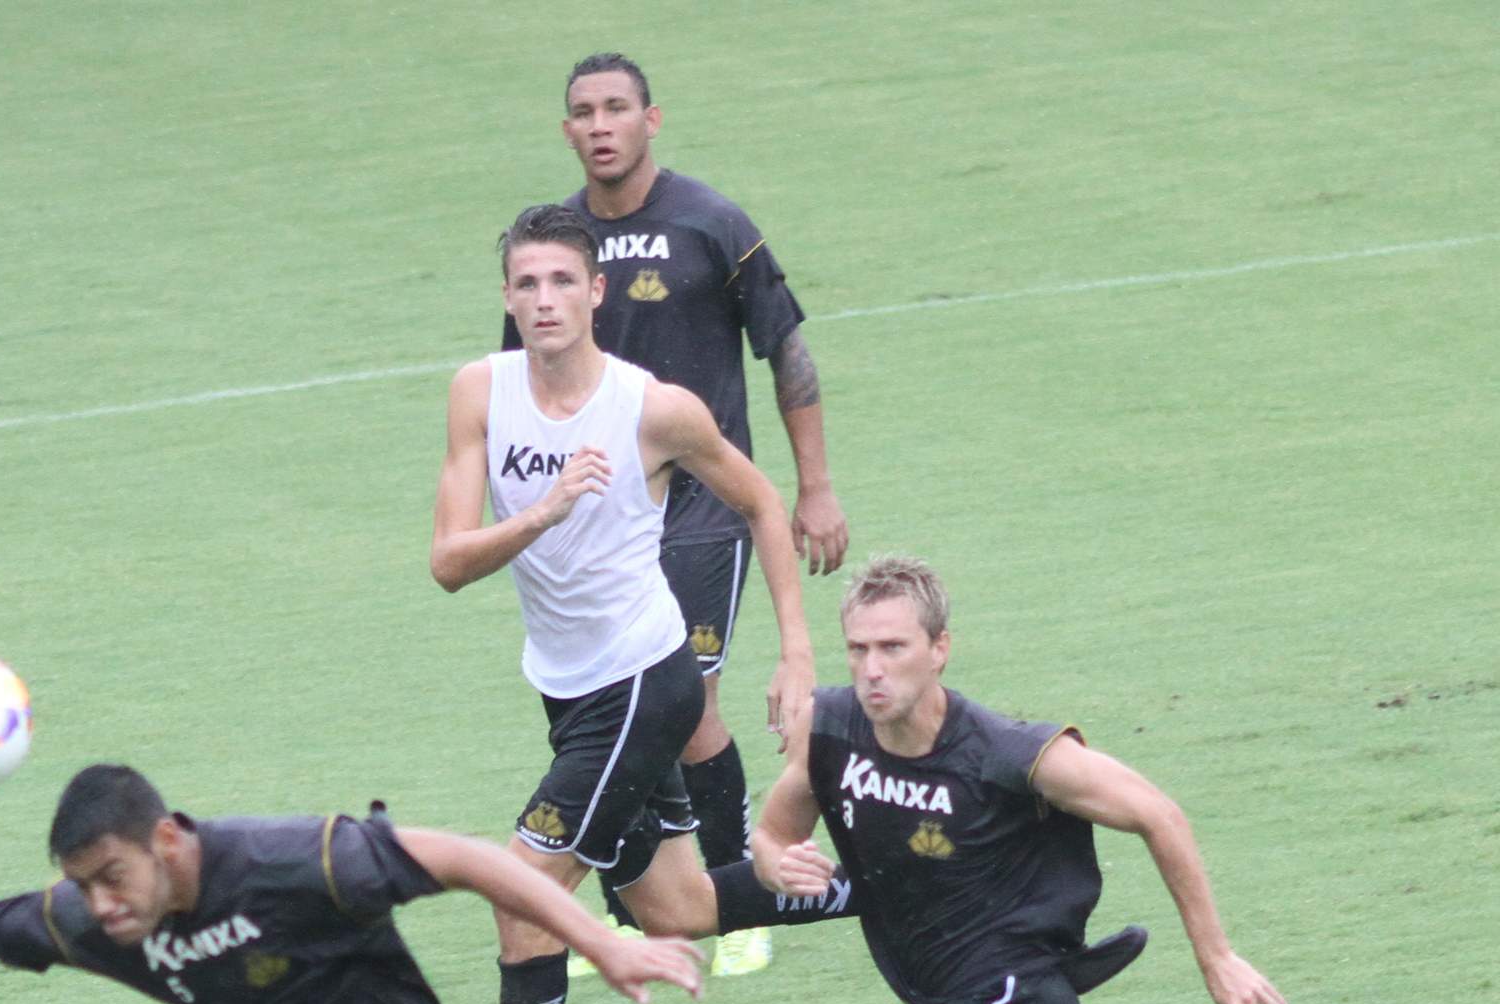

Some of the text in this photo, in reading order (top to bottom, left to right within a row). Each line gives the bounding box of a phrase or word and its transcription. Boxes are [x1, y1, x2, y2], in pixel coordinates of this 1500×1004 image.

[597, 233, 670, 263] NXA
[501, 444, 576, 482] KAN
[840, 752, 953, 815] KANXA
[142, 914, 262, 972] KANXA
